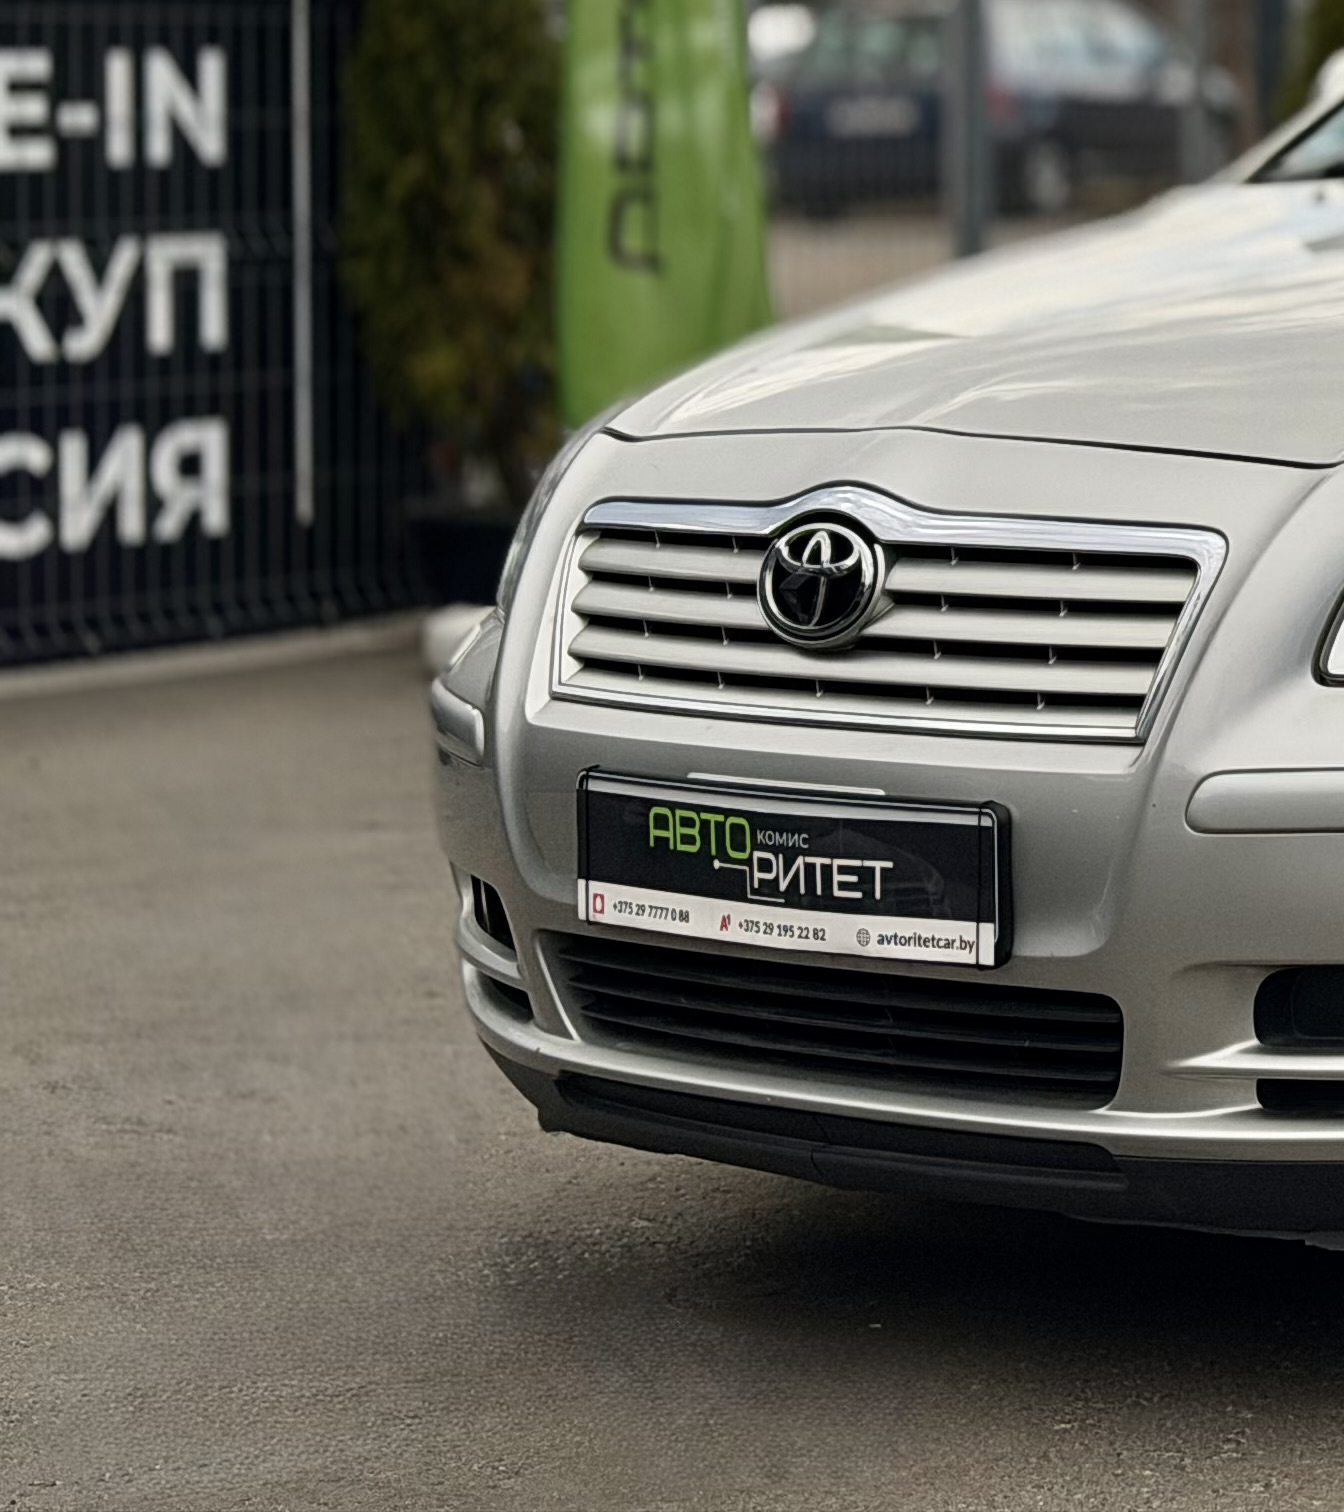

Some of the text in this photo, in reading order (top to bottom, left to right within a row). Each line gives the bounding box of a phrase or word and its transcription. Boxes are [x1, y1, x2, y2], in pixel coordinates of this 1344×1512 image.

[0, 46, 228, 172] E-IN
[0, 416, 230, 560] СИЯ
[649, 806, 809, 859] АВТО КОМИС
[752, 851, 894, 900] РИТЕТ
[613, 901, 633, 915] +375
[635, 903, 645, 916] 29
[648, 904, 670, 920] 7777
[738, 919, 826, 941] +375 29 195 22 82
[877, 931, 976, 955] avtoritetcar.by
